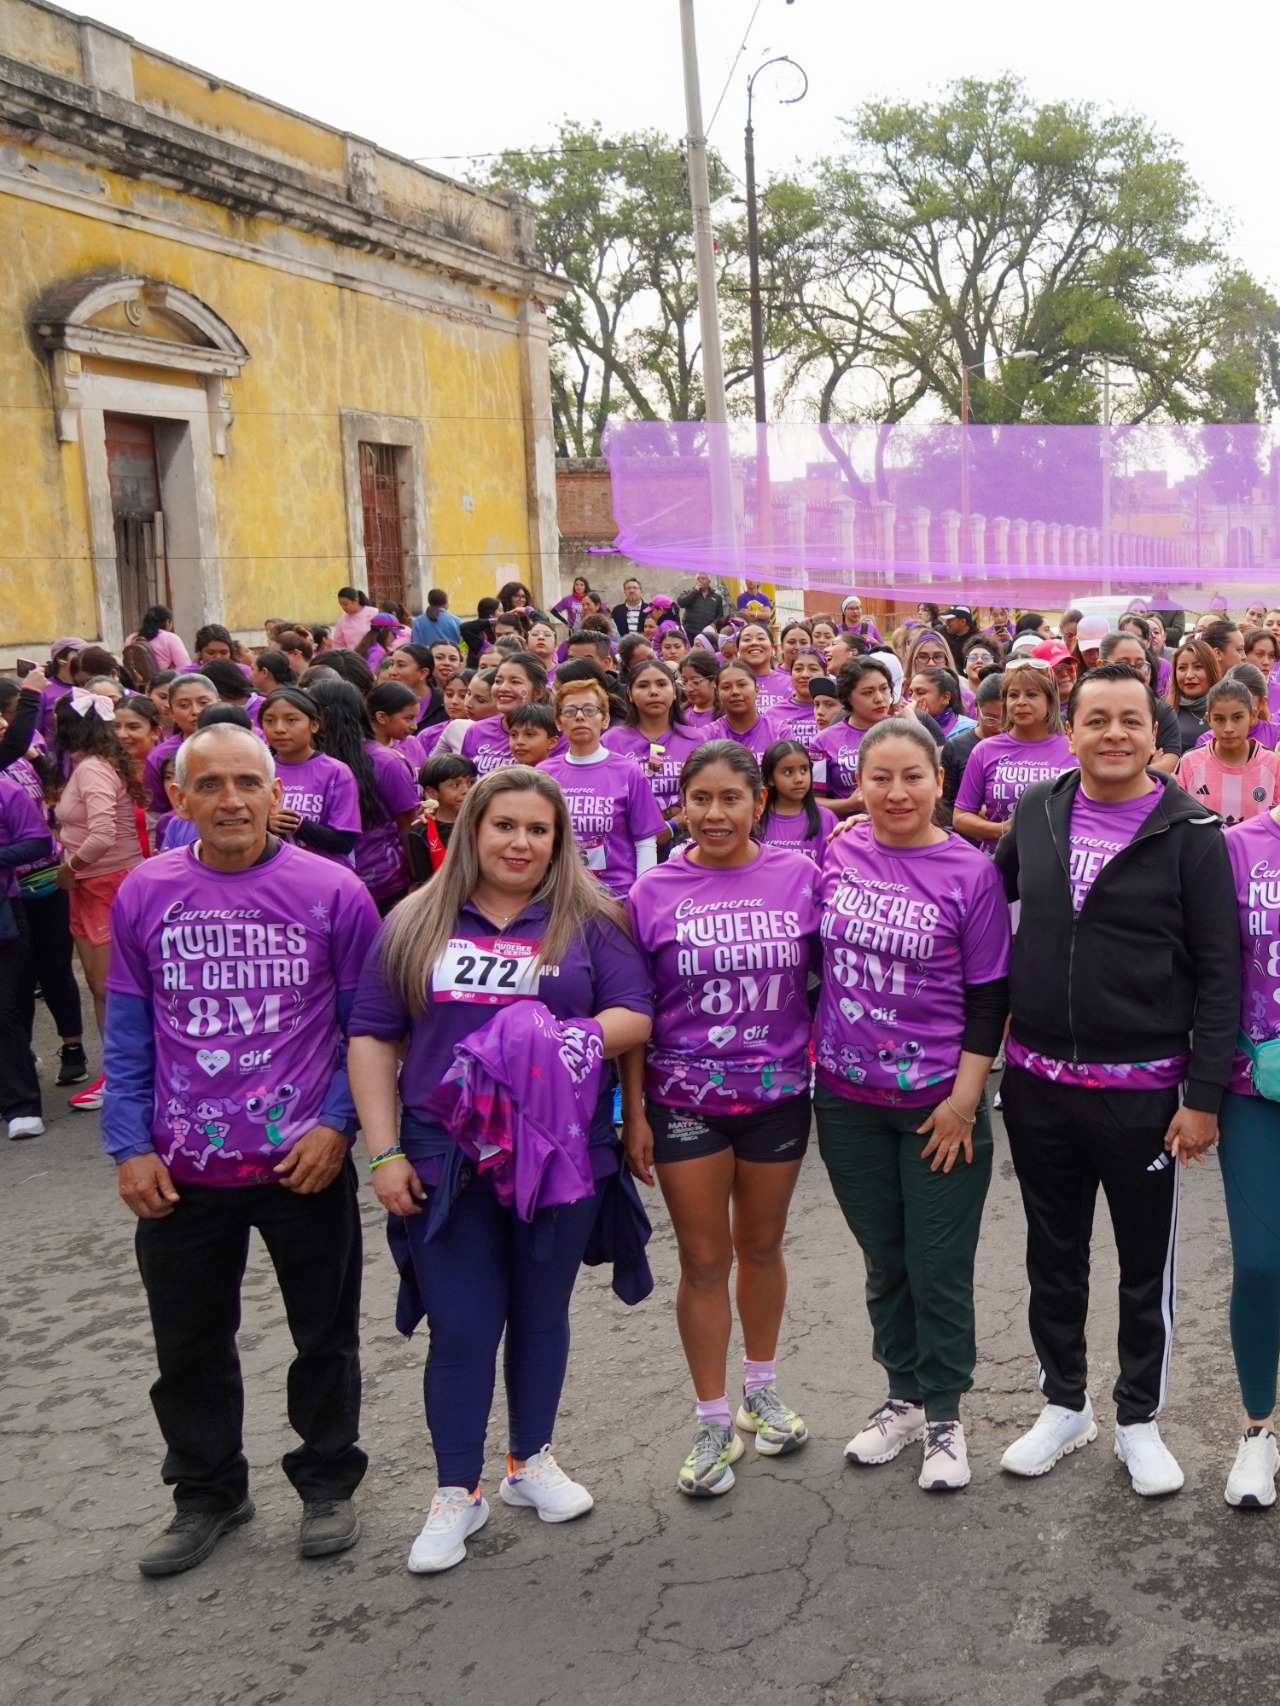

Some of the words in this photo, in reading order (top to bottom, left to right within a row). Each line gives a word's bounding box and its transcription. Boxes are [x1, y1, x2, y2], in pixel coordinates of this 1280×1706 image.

[756, 695, 784, 707] ERES
[282, 793, 324, 813] ERES
[993, 784, 1010, 799] AL
[571, 816, 614, 833] ENTRO
[840, 867, 911, 894] Carrera
[163, 900, 264, 924] Carrera
[675, 898, 765, 920] Carrera
[828, 884, 940, 932] MUJERES
[675, 910, 800, 946] MUJERES
[820, 912, 838, 941] AL
[844, 918, 935, 960] CENTRO
[1249, 911, 1273, 936] AL
[161, 923, 308, 960] MUJERES
[454, 955, 519, 988] 272
[678, 950, 707, 976] AL
[714, 941, 800, 974] CENTRO
[832, 947, 908, 996] 8M
[162, 962, 194, 990] AL
[202, 958, 310, 990] CENTRO
[699, 974, 785, 1015] 8M
[186, 994, 284, 1037] 8M
[870, 1007, 897, 1021] dif
[743, 1024, 770, 1041] dif
[239, 1049, 272, 1067] dif
